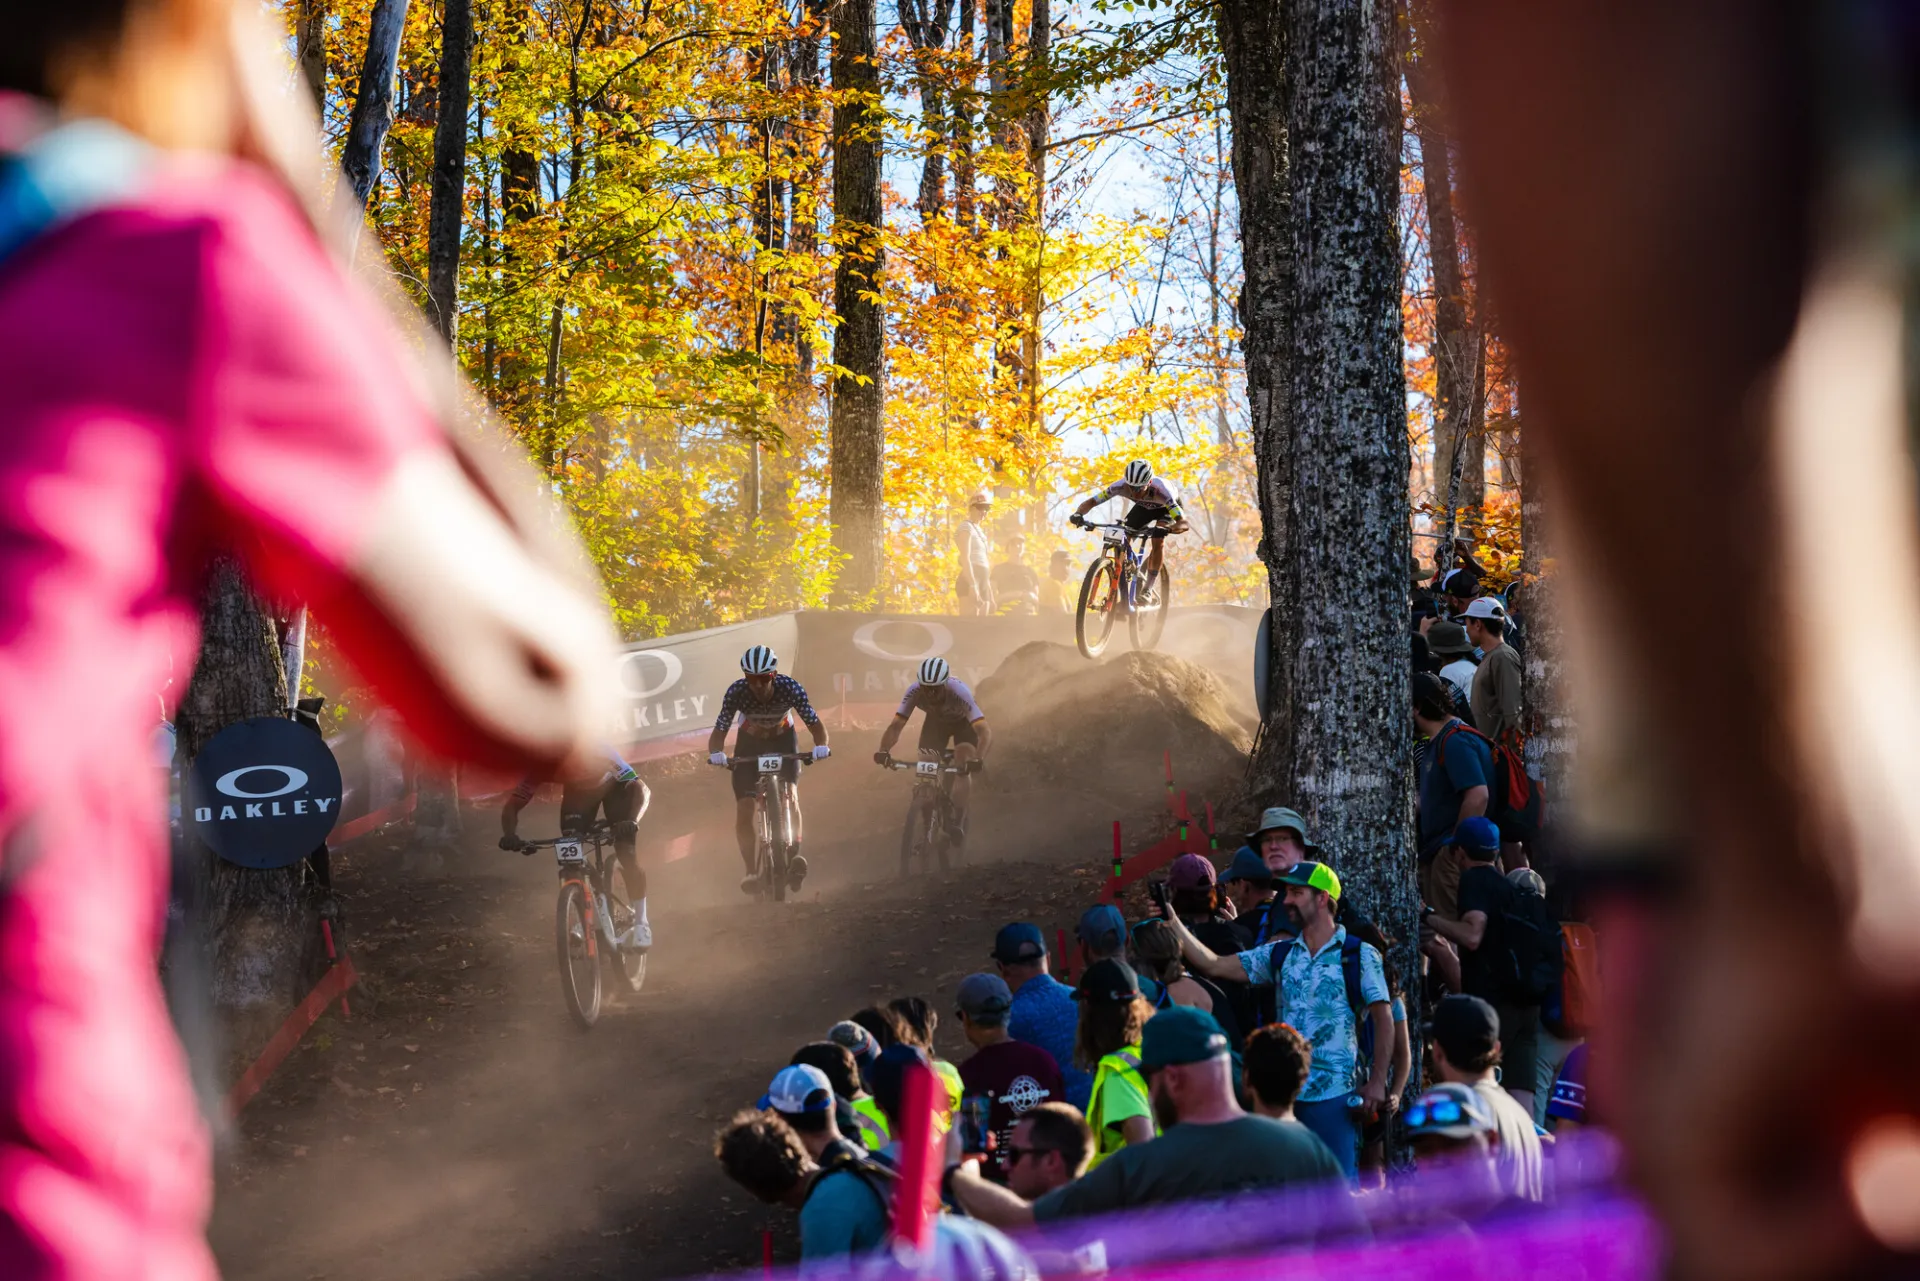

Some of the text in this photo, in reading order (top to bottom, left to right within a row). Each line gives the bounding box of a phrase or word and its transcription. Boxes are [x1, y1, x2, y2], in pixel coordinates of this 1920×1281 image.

[611, 694, 709, 732] AKLEY
[762, 759, 779, 769] 45
[920, 763, 934, 773] 16
[195, 798, 335, 822] OAKLEY
[560, 846, 578, 858] 29
